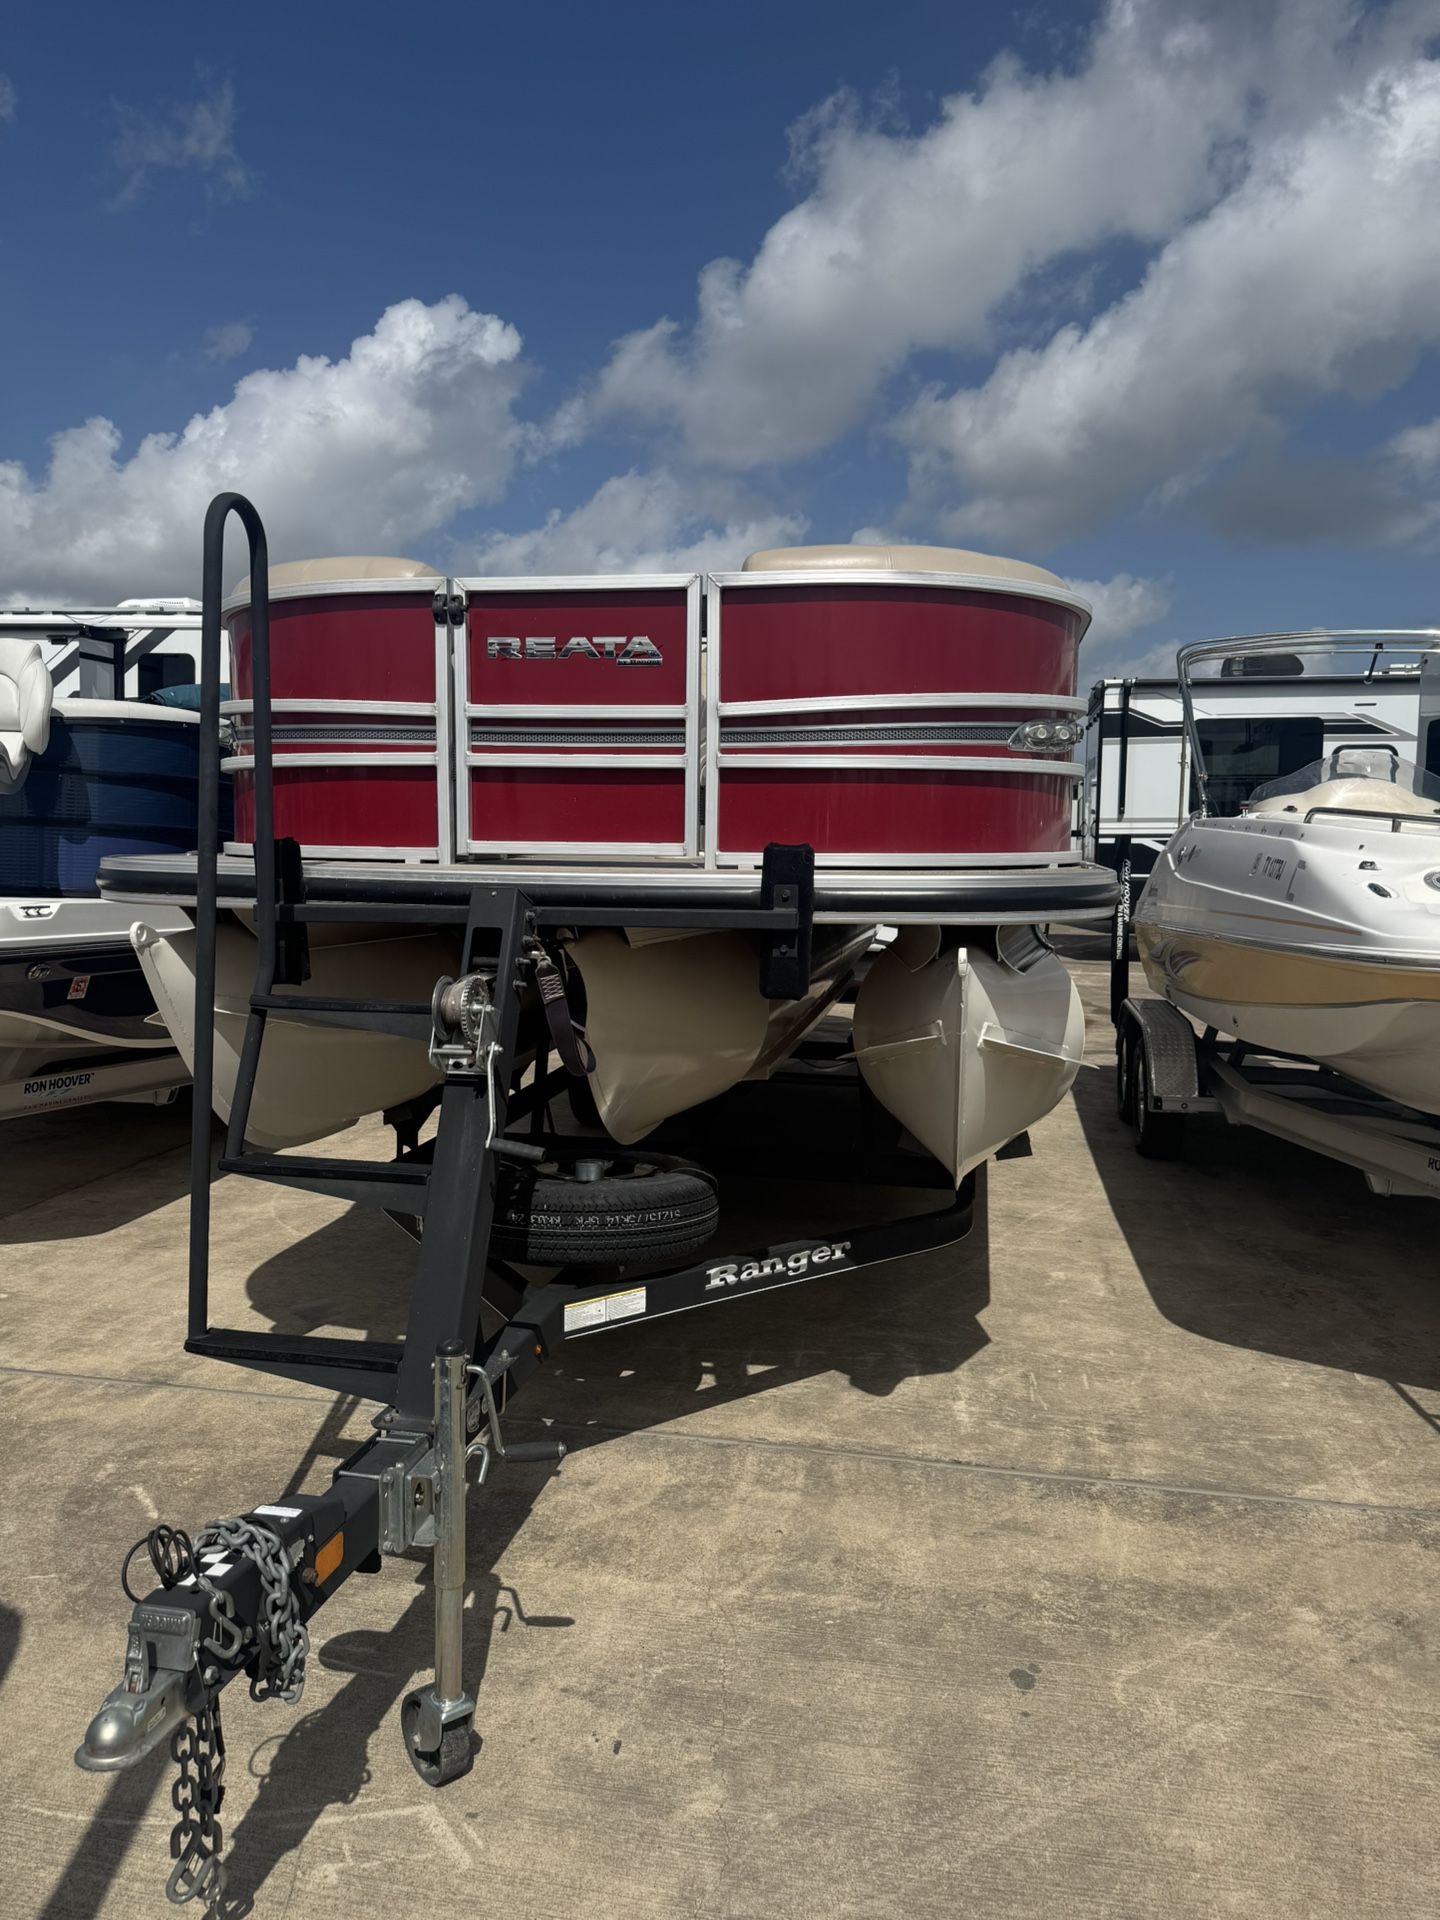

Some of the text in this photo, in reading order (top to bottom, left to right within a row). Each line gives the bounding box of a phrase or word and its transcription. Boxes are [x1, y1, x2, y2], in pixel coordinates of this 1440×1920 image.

[487, 636, 662, 659] REATA
[1123, 882, 1131, 923] HOOVER
[24, 1073, 91, 1094] RON HOOVER
[705, 1241, 851, 1290] Ranger
